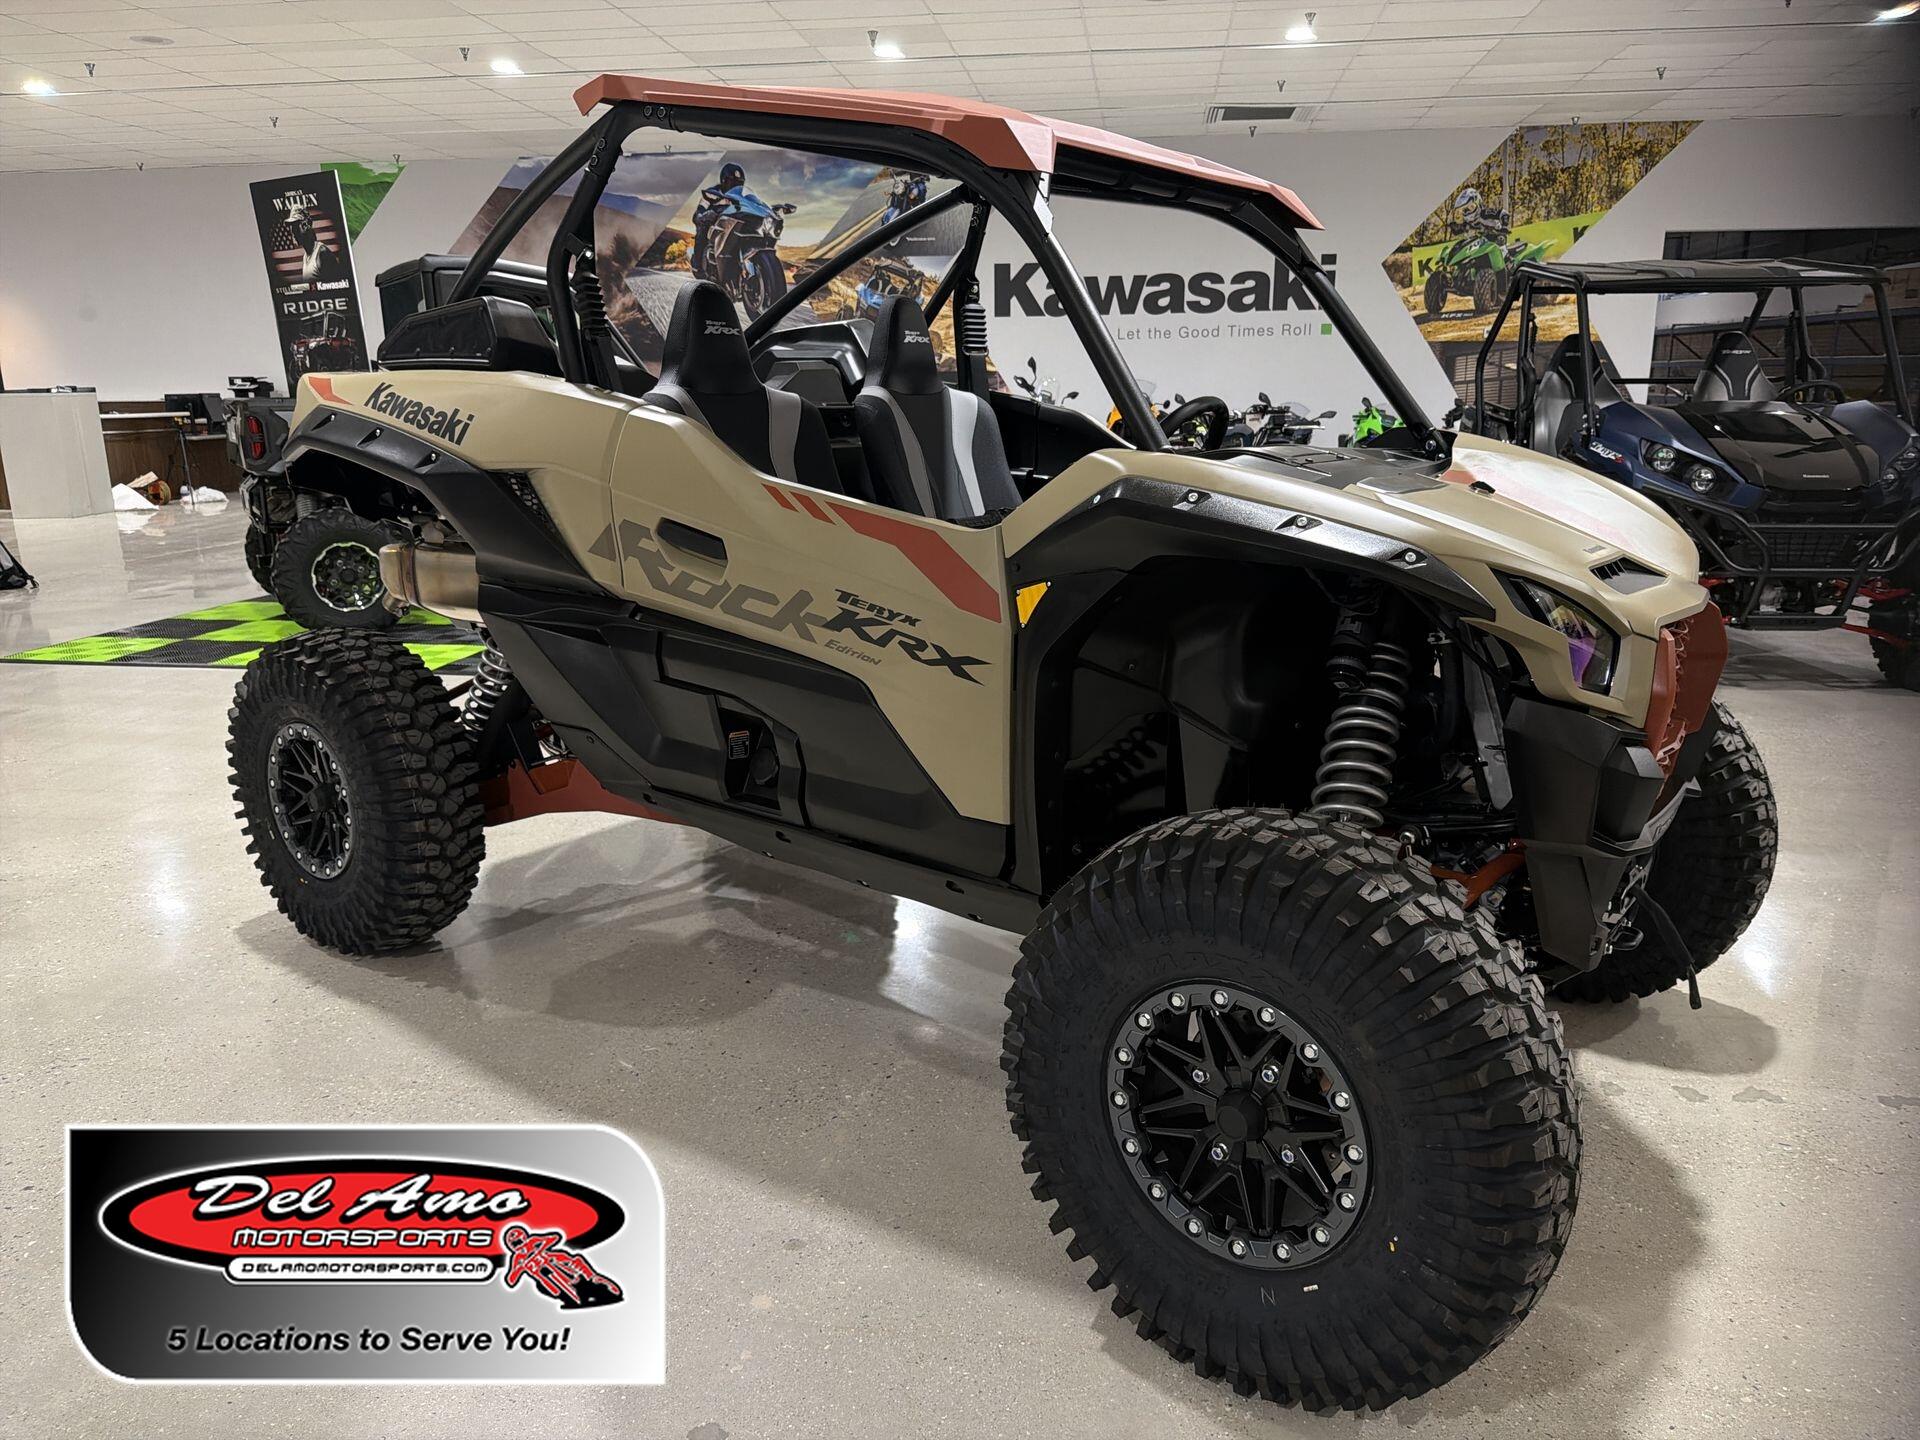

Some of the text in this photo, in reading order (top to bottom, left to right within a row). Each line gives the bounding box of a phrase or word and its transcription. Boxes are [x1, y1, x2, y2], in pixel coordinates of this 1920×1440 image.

[316, 279, 349, 291] Kawasaki
[283, 298, 348, 315] RIDGE
[704, 325, 741, 336] KRX
[1117, 323, 1313, 340] Let the Good Times Roll
[363, 382, 475, 446] Kawasaki
[822, 606, 993, 687] KRX
